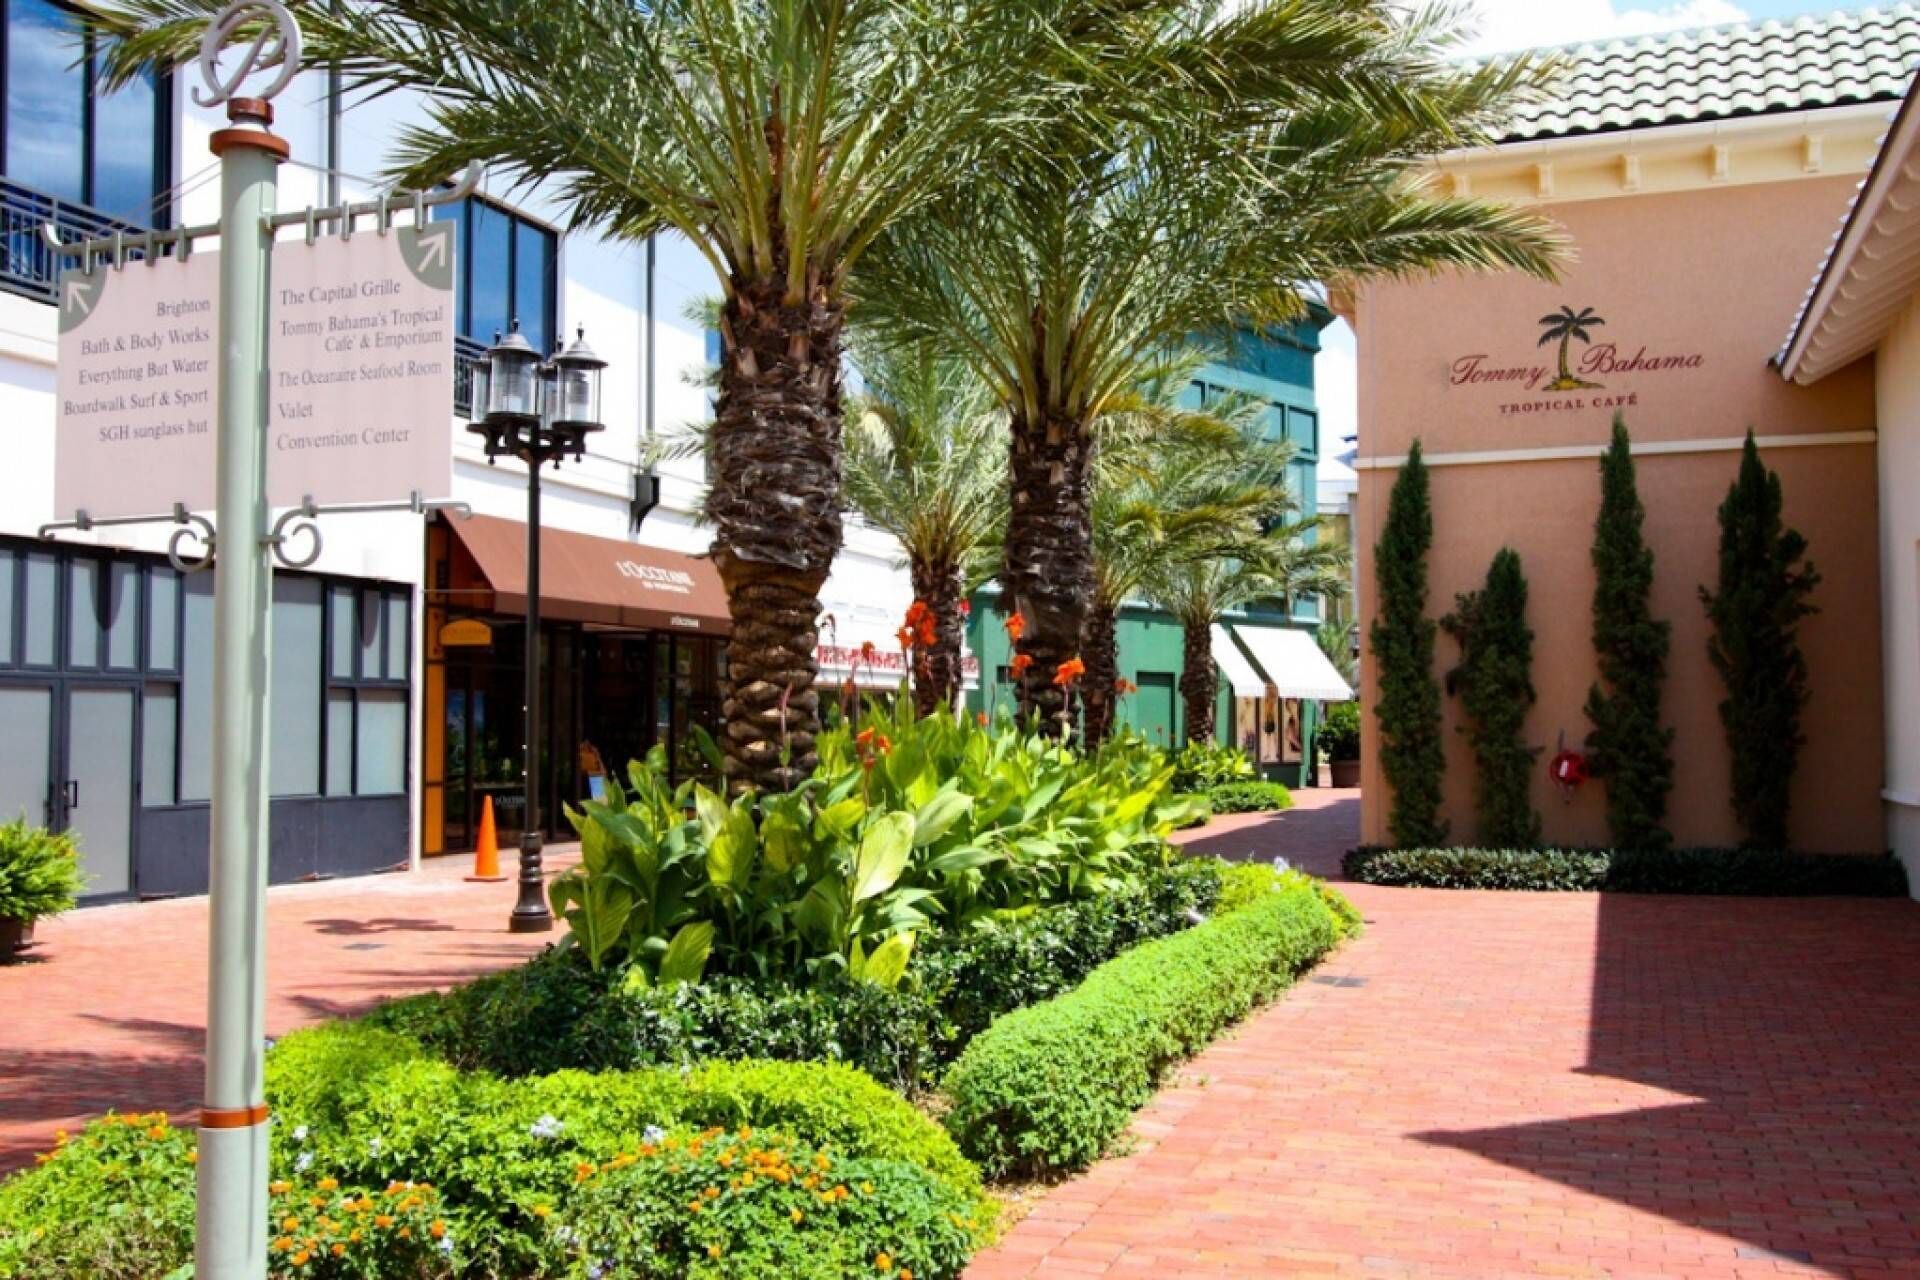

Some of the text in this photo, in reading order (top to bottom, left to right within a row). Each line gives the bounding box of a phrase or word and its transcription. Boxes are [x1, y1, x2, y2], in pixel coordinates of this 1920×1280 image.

[280, 279, 401, 306] The Capital Grille
[156, 299, 210, 317] Brighton
[280, 306, 443, 337] Tommy Bahama's Tropical
[81, 326, 209, 355] Bath & Body Works
[360, 334, 370, 349] &
[375, 329, 443, 350] Emporium
[78, 358, 209, 385] Everything But Water
[279, 360, 442, 387] The Oceanaire Seafood Room
[1450, 342, 1703, 390] Tommy Bahama
[64, 389, 208, 416] Boardwalk Surf & Sport
[278, 402, 313, 419] Valet
[1499, 392, 1638, 414] TROPICAL CAFÉ
[98, 425, 129, 442] SGH
[133, 421, 184, 440] sunglass
[277, 428, 410, 451] Convention Center
